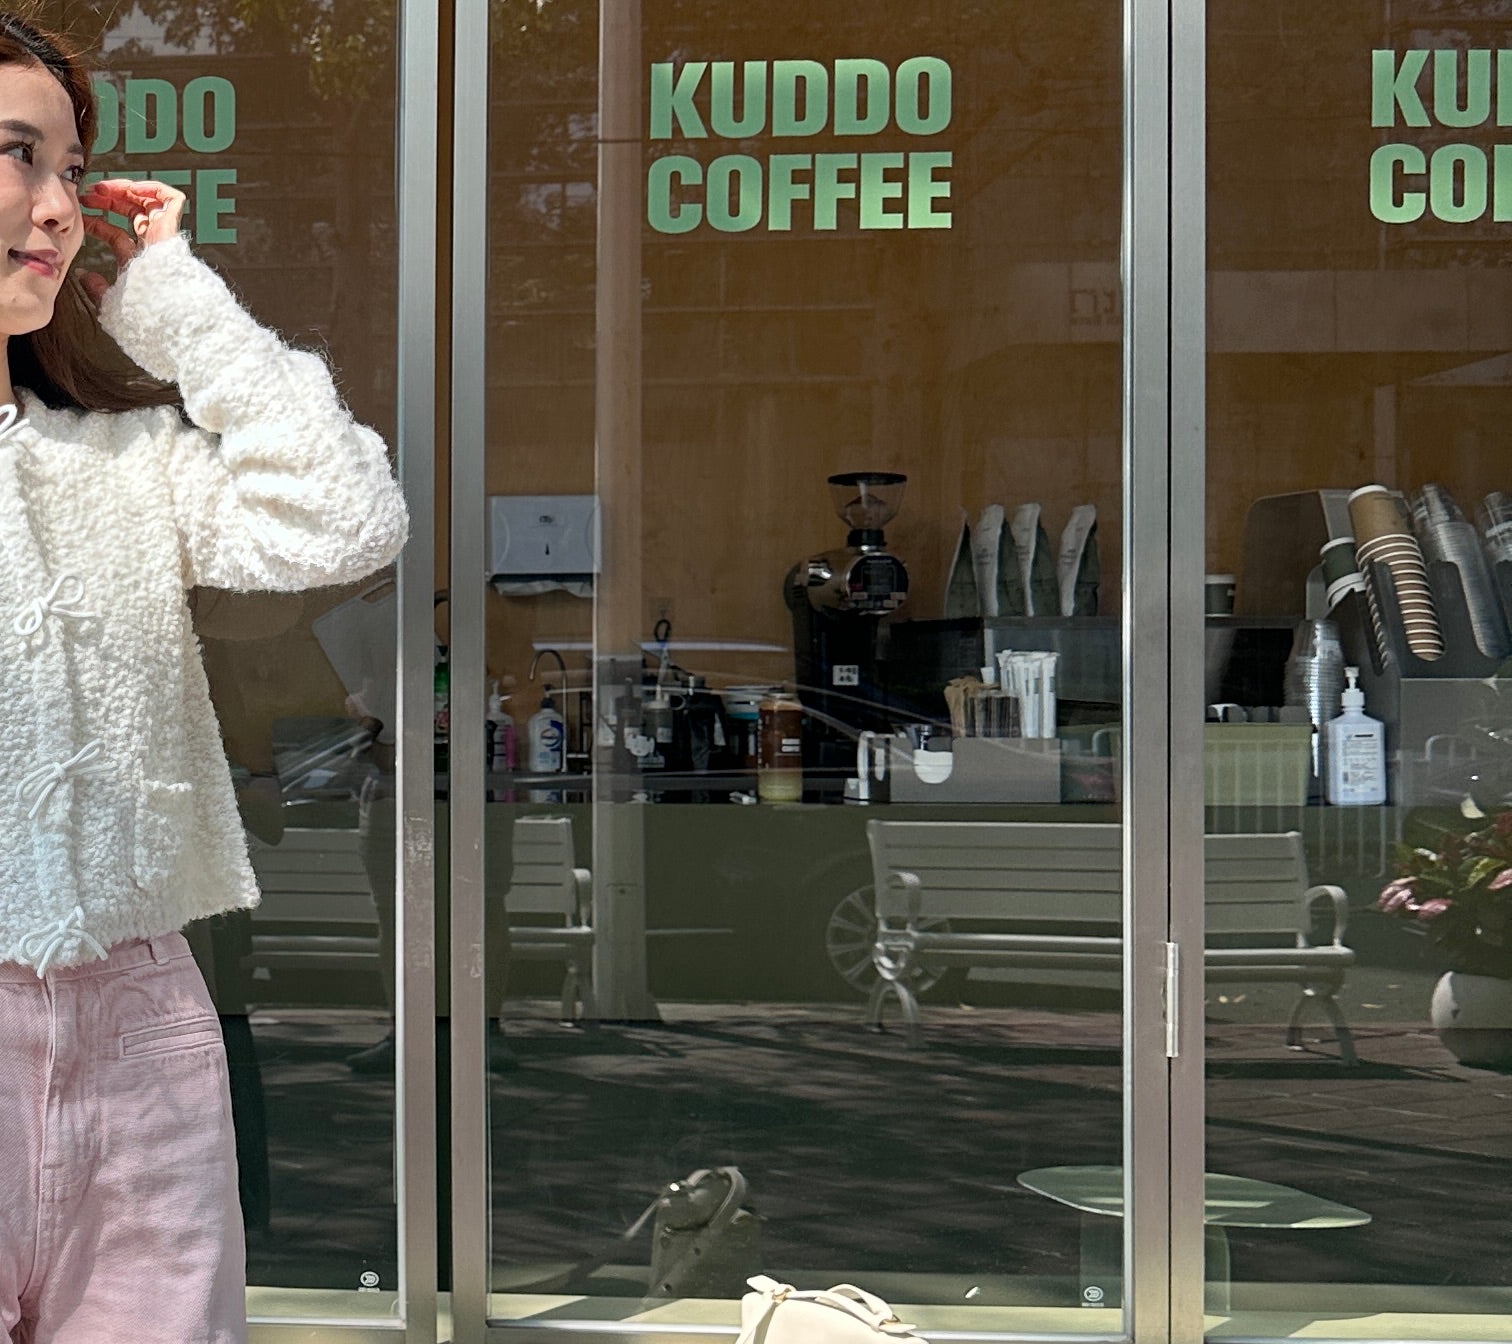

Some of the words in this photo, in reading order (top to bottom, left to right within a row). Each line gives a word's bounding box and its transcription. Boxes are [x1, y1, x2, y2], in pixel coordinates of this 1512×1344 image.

[650, 56, 953, 140] KUDDO
[1371, 48, 1512, 128] KU
[647, 151, 953, 234] COFFEE
